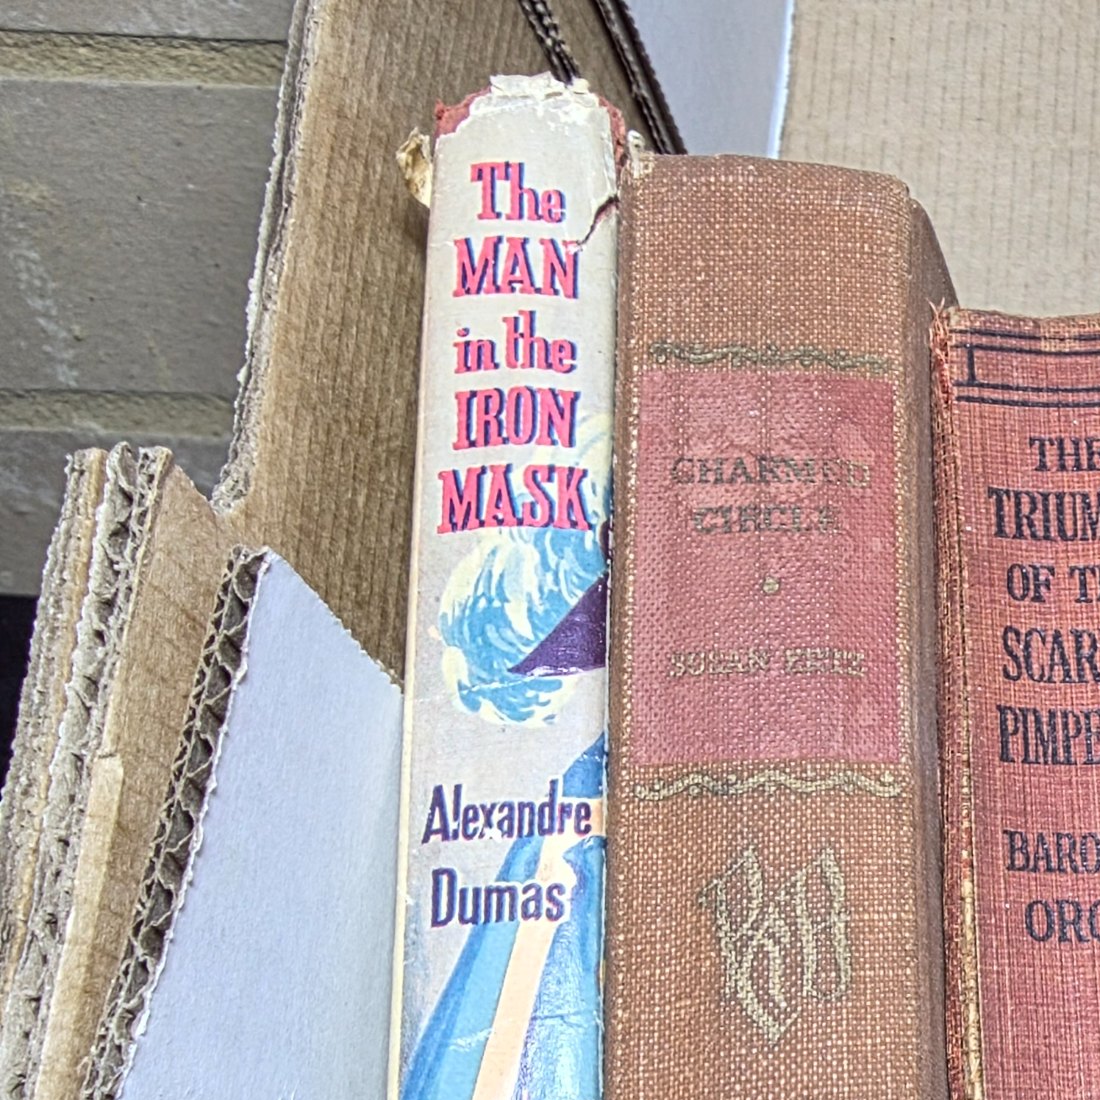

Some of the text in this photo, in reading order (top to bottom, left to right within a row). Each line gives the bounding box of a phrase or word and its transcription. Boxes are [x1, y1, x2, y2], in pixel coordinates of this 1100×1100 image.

[469, 158, 567, 224] The
[450, 233, 583, 299] MAN
[452, 308, 578, 376] in the
[451, 386, 582, 452] IRON
[435, 461, 597, 536] MASK
[1006, 562, 1056, 603] OF
[421, 778, 593, 845] Alexandre
[430, 866, 567, 928] Dumas
